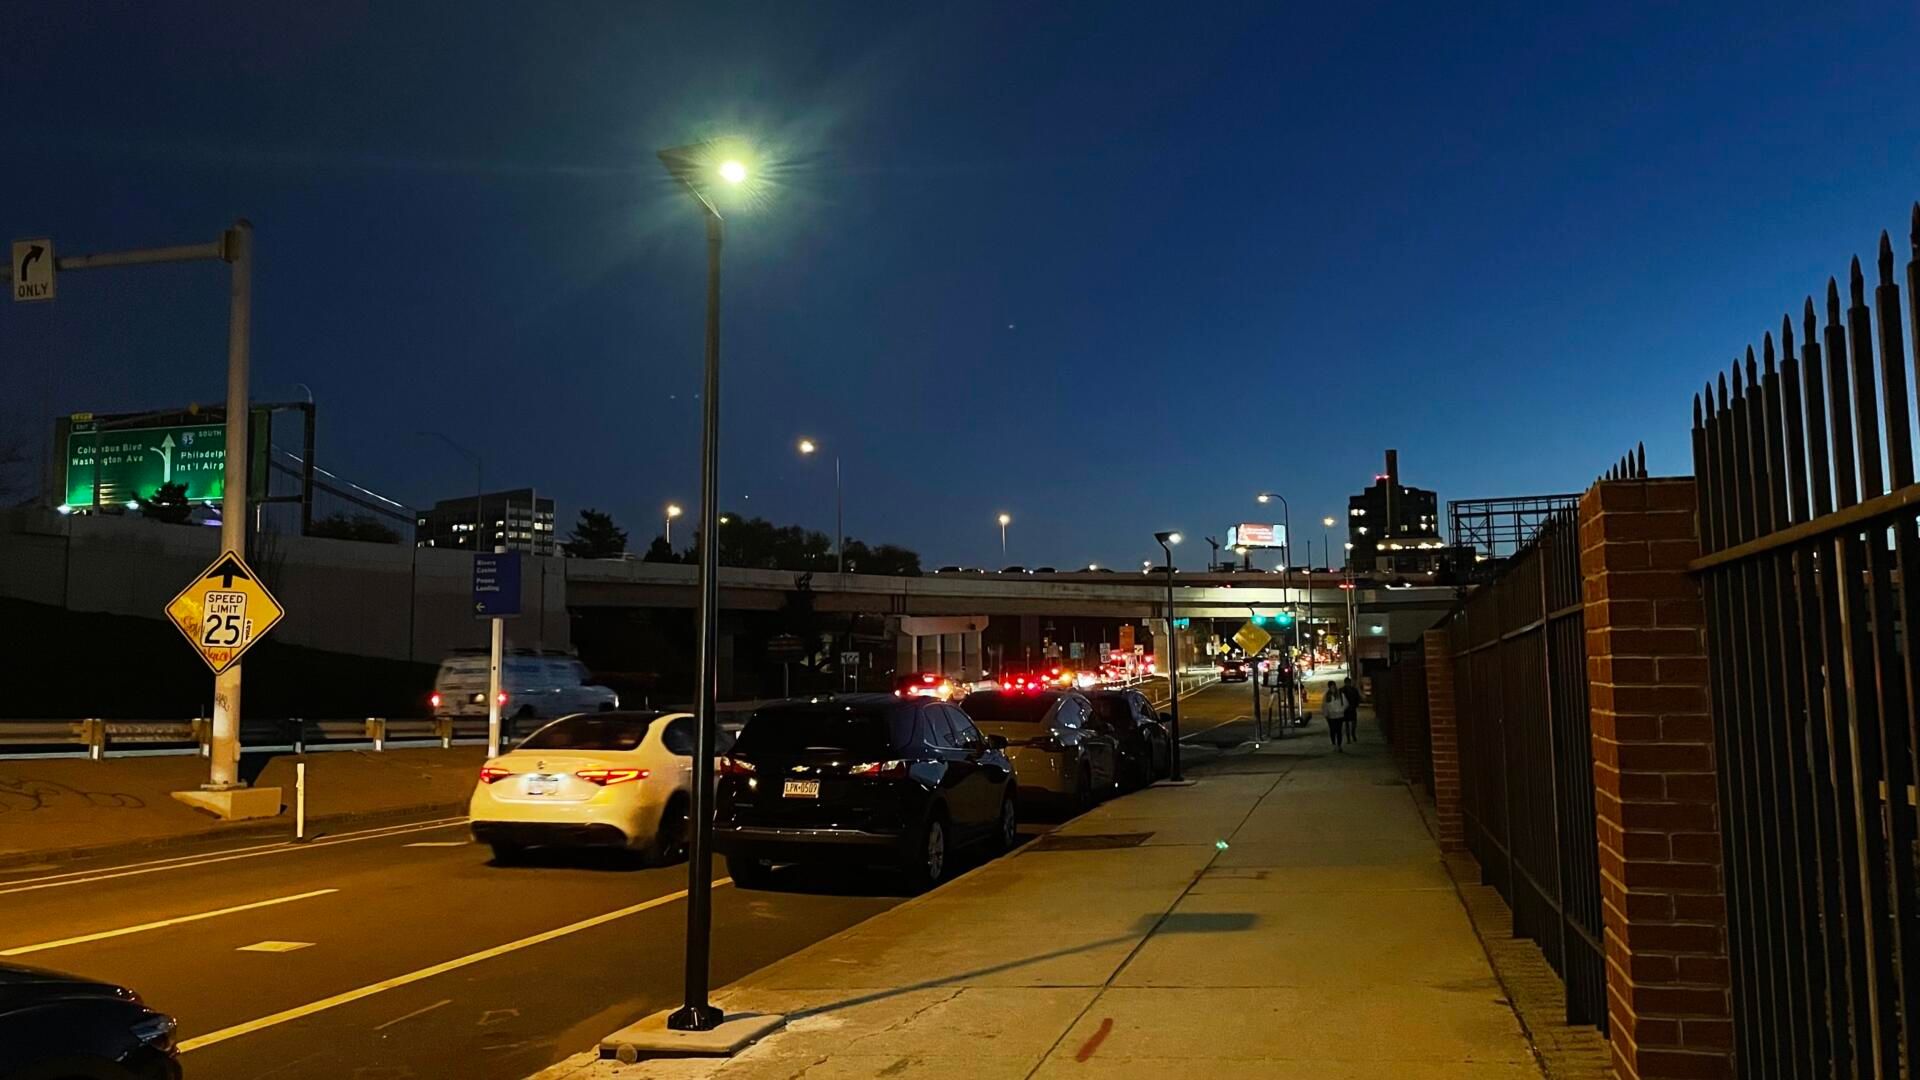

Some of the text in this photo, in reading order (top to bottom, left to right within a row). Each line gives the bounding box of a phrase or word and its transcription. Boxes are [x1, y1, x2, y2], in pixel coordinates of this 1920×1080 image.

[18, 283, 48, 298] ONLY
[198, 429, 222, 438] SOUTH
[122, 443, 143, 452] Blvd
[72, 454, 144, 466] Washgton Ave
[202, 461, 225, 471] Airp
[208, 594, 243, 604] SPEED
[210, 604, 238, 613] LIMIT
[204, 614, 241, 645] 25
